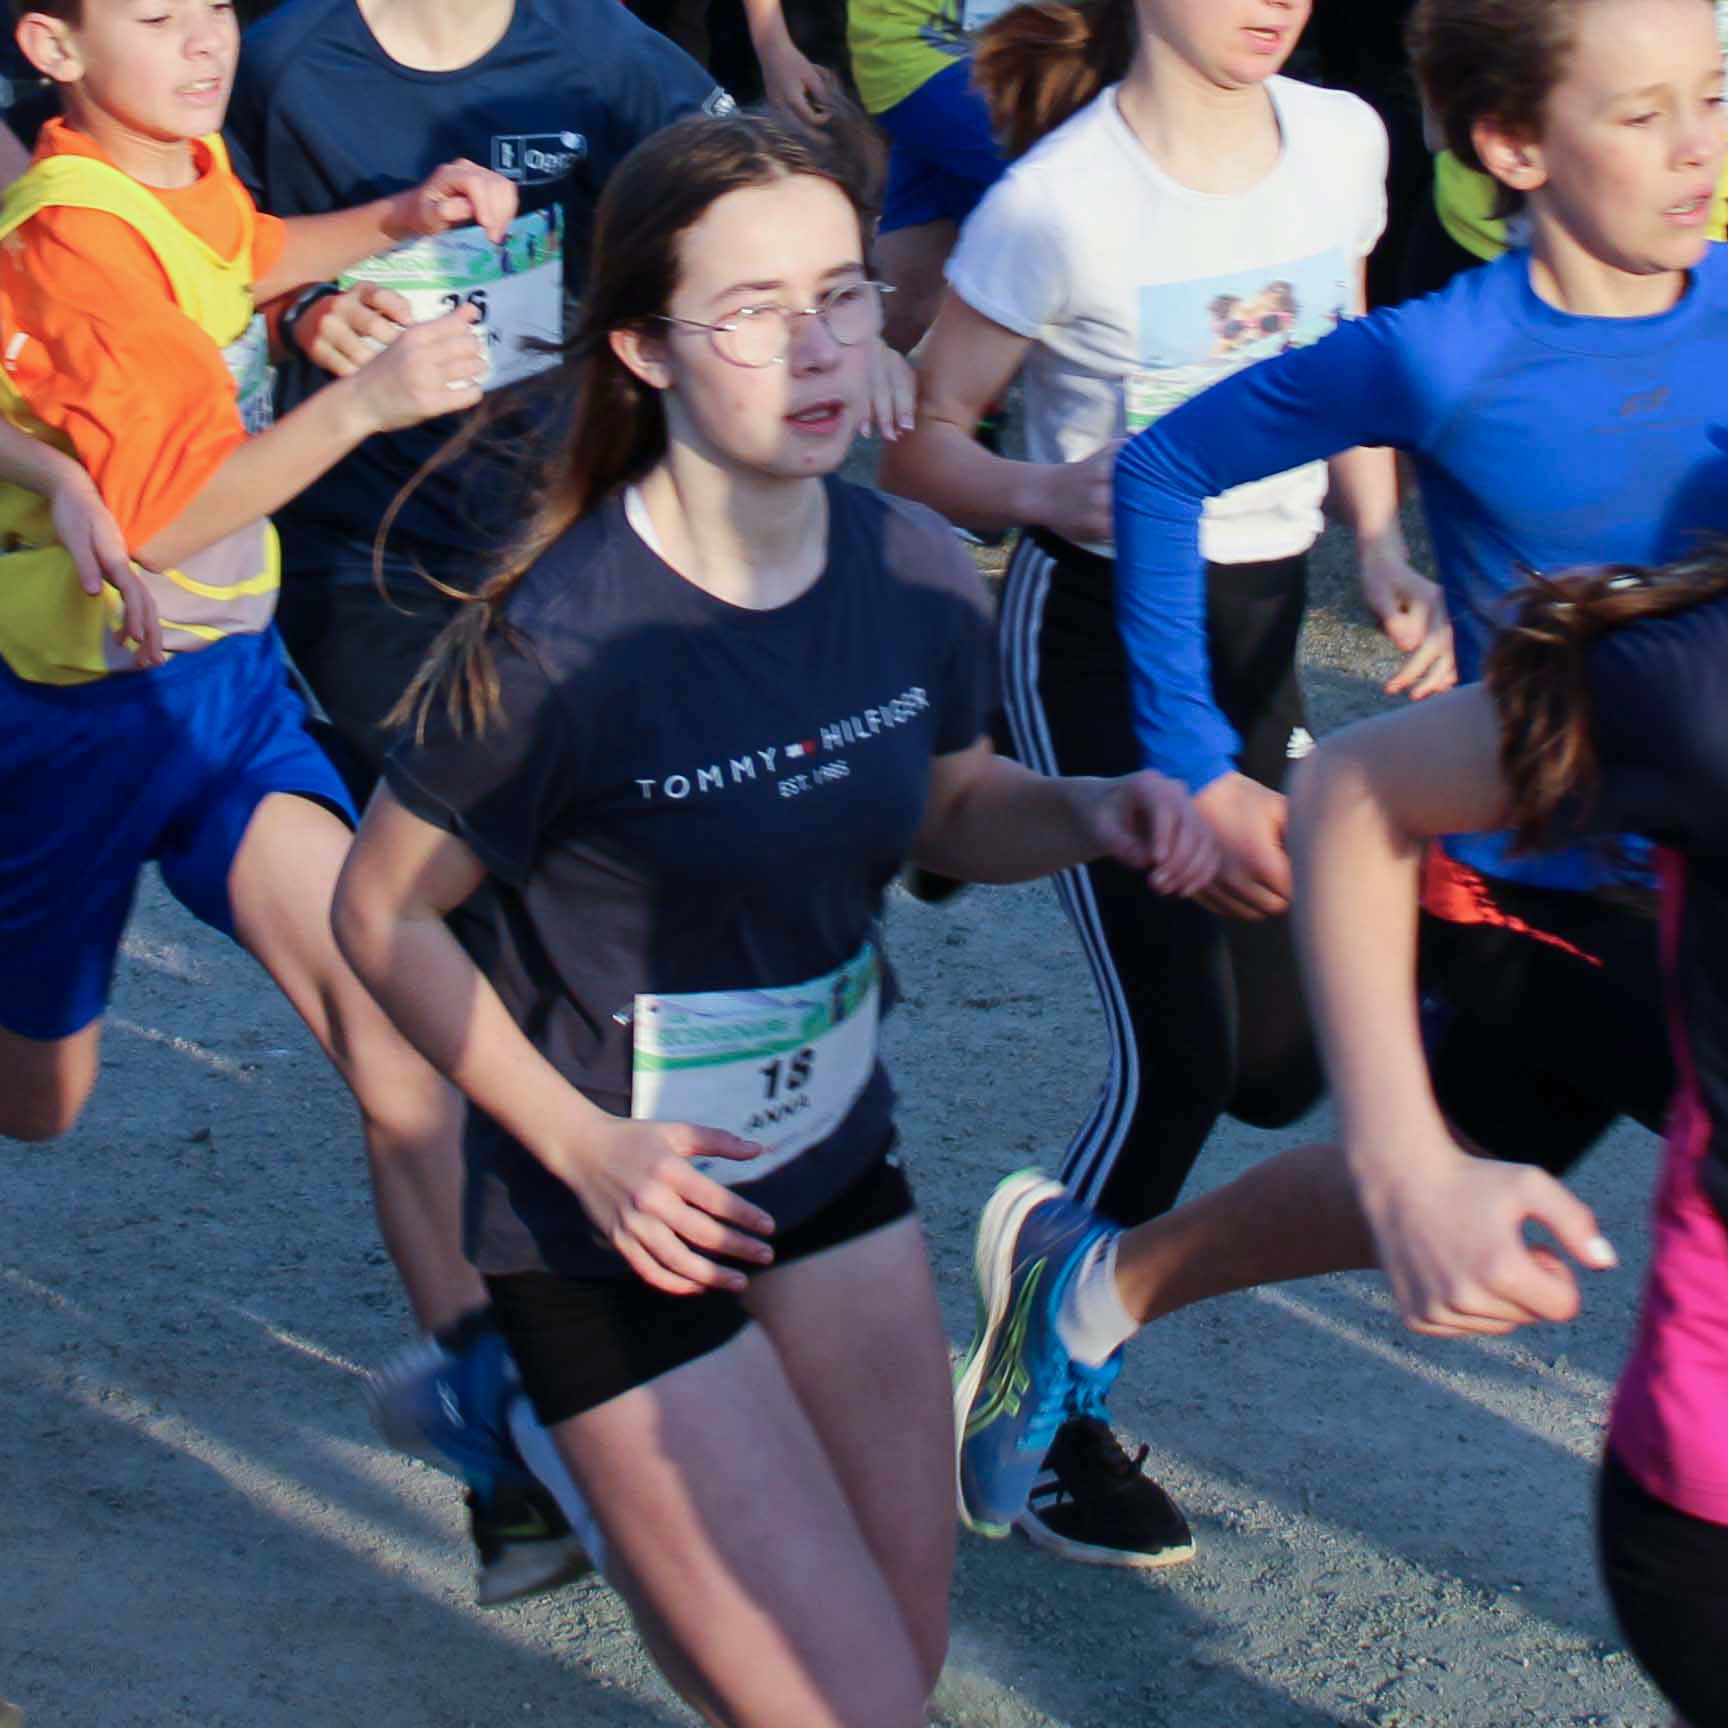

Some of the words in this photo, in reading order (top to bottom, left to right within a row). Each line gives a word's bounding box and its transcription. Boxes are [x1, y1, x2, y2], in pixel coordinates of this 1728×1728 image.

[634, 746, 776, 799] TOMMY
[820, 686, 930, 752] HILFIGER
[760, 1048, 813, 1100] 18
